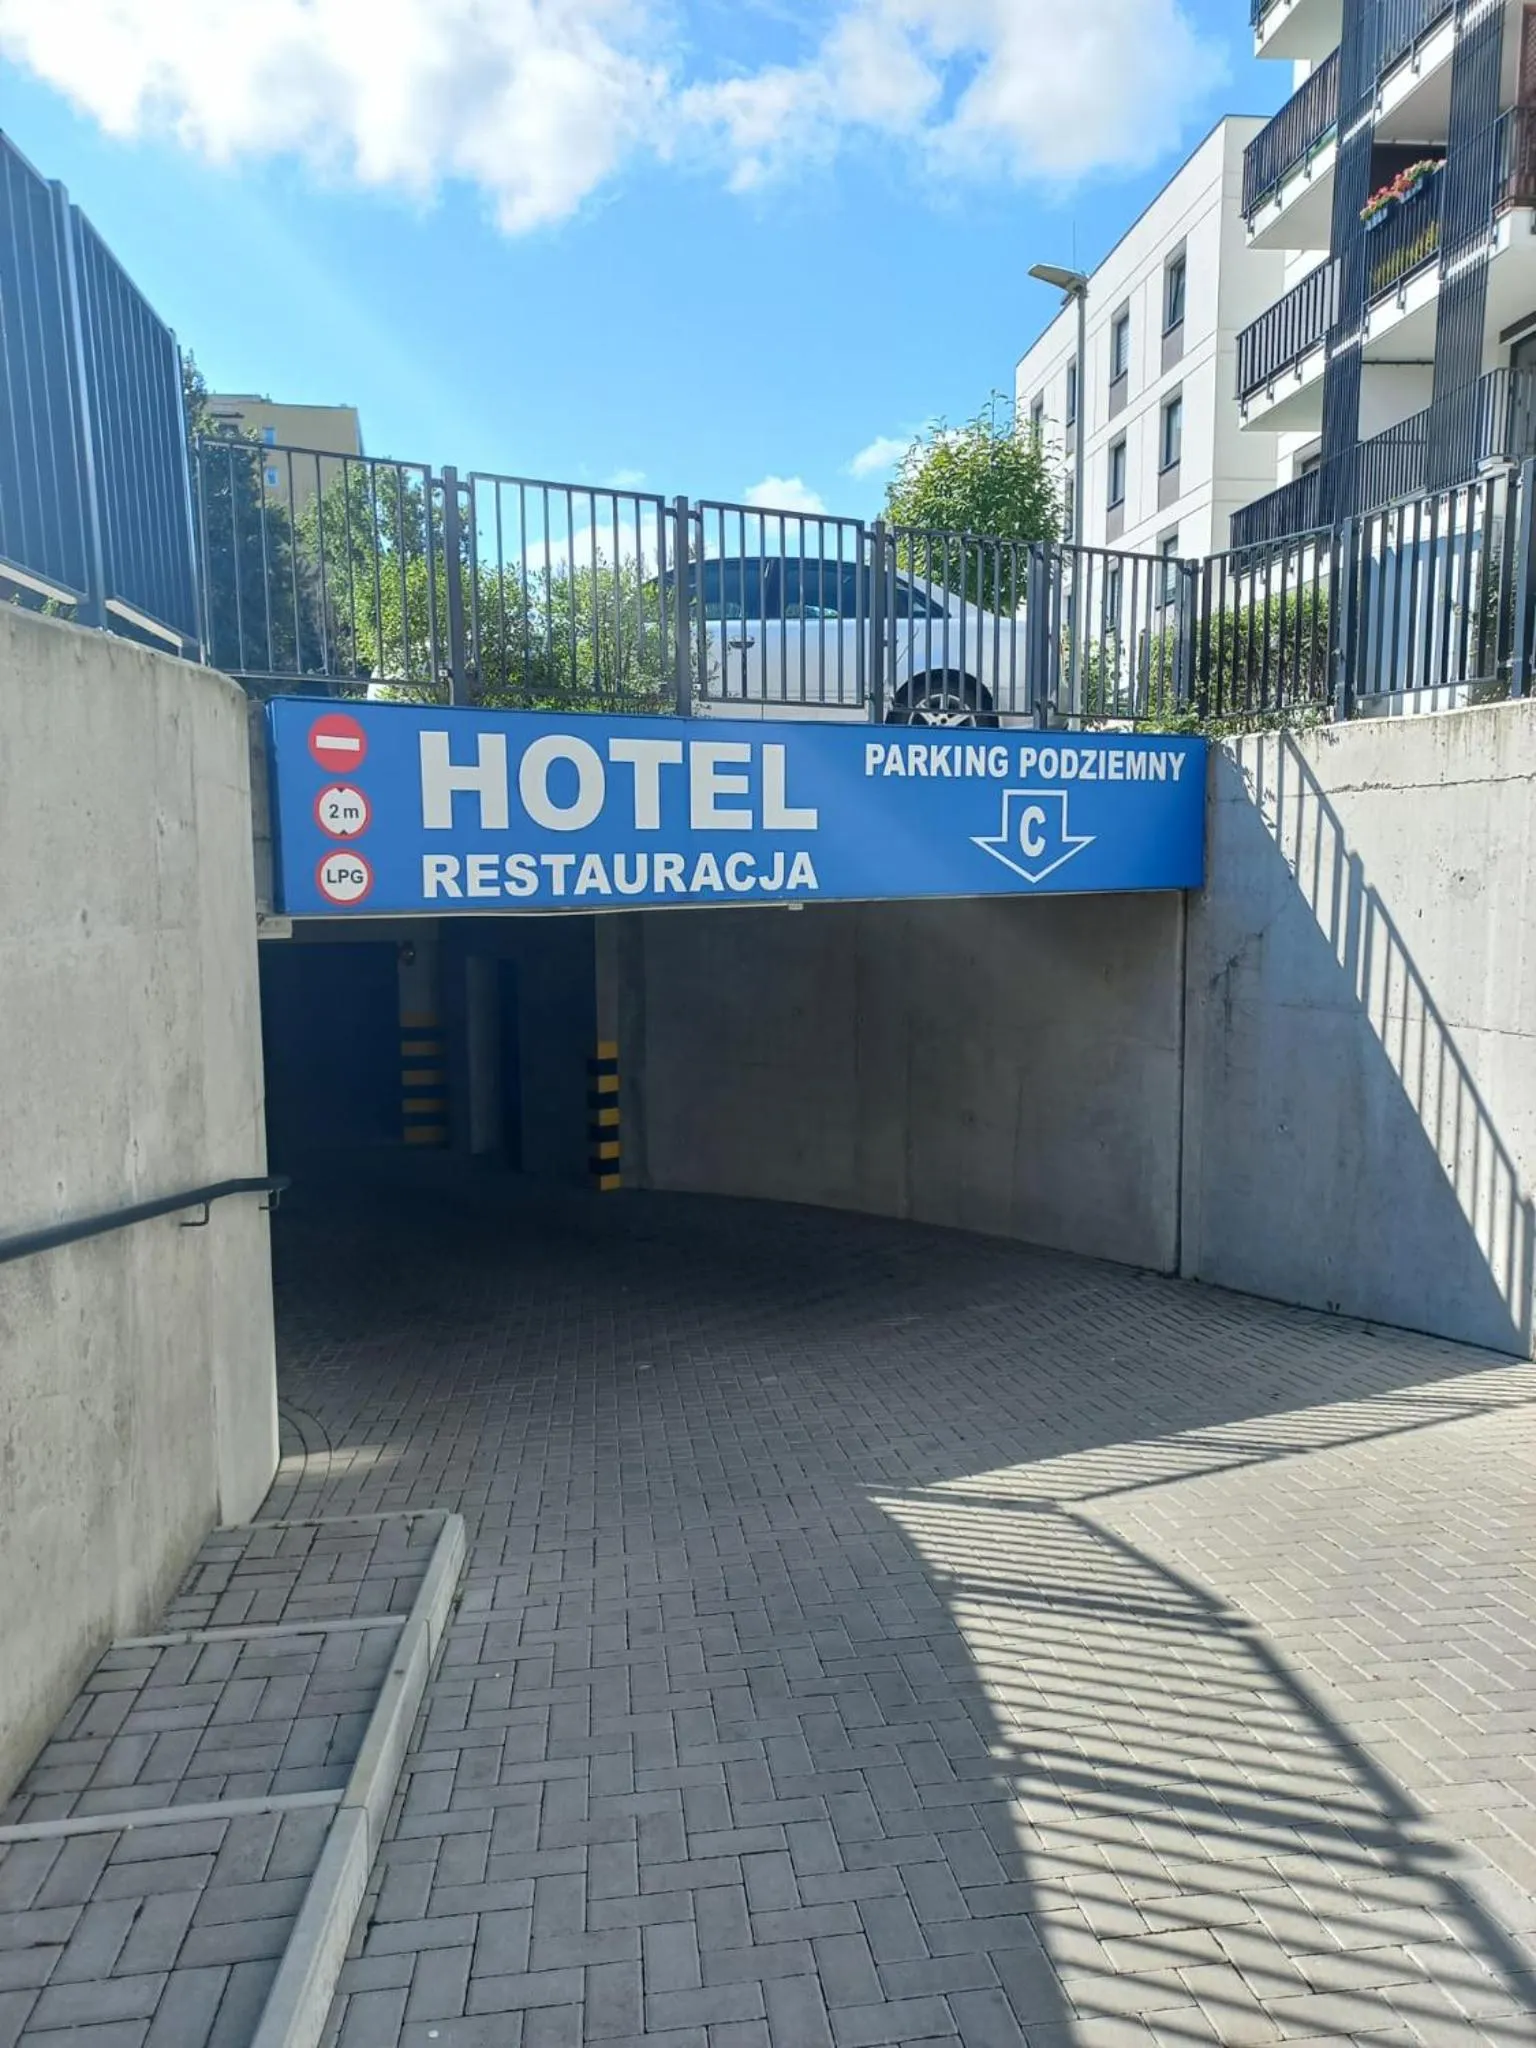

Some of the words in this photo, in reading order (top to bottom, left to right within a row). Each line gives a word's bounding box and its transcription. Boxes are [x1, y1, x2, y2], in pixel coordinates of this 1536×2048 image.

[419, 731, 818, 831] HOTEL
[865, 743, 1009, 778] PARKING
[1020, 747, 1186, 781] PODZIEMNY
[328, 804, 339, 819] 2
[343, 807, 360, 819] m
[1019, 805, 1047, 857] C
[327, 869, 364, 884] LPG
[422, 852, 819, 898] RESTAURACJA
